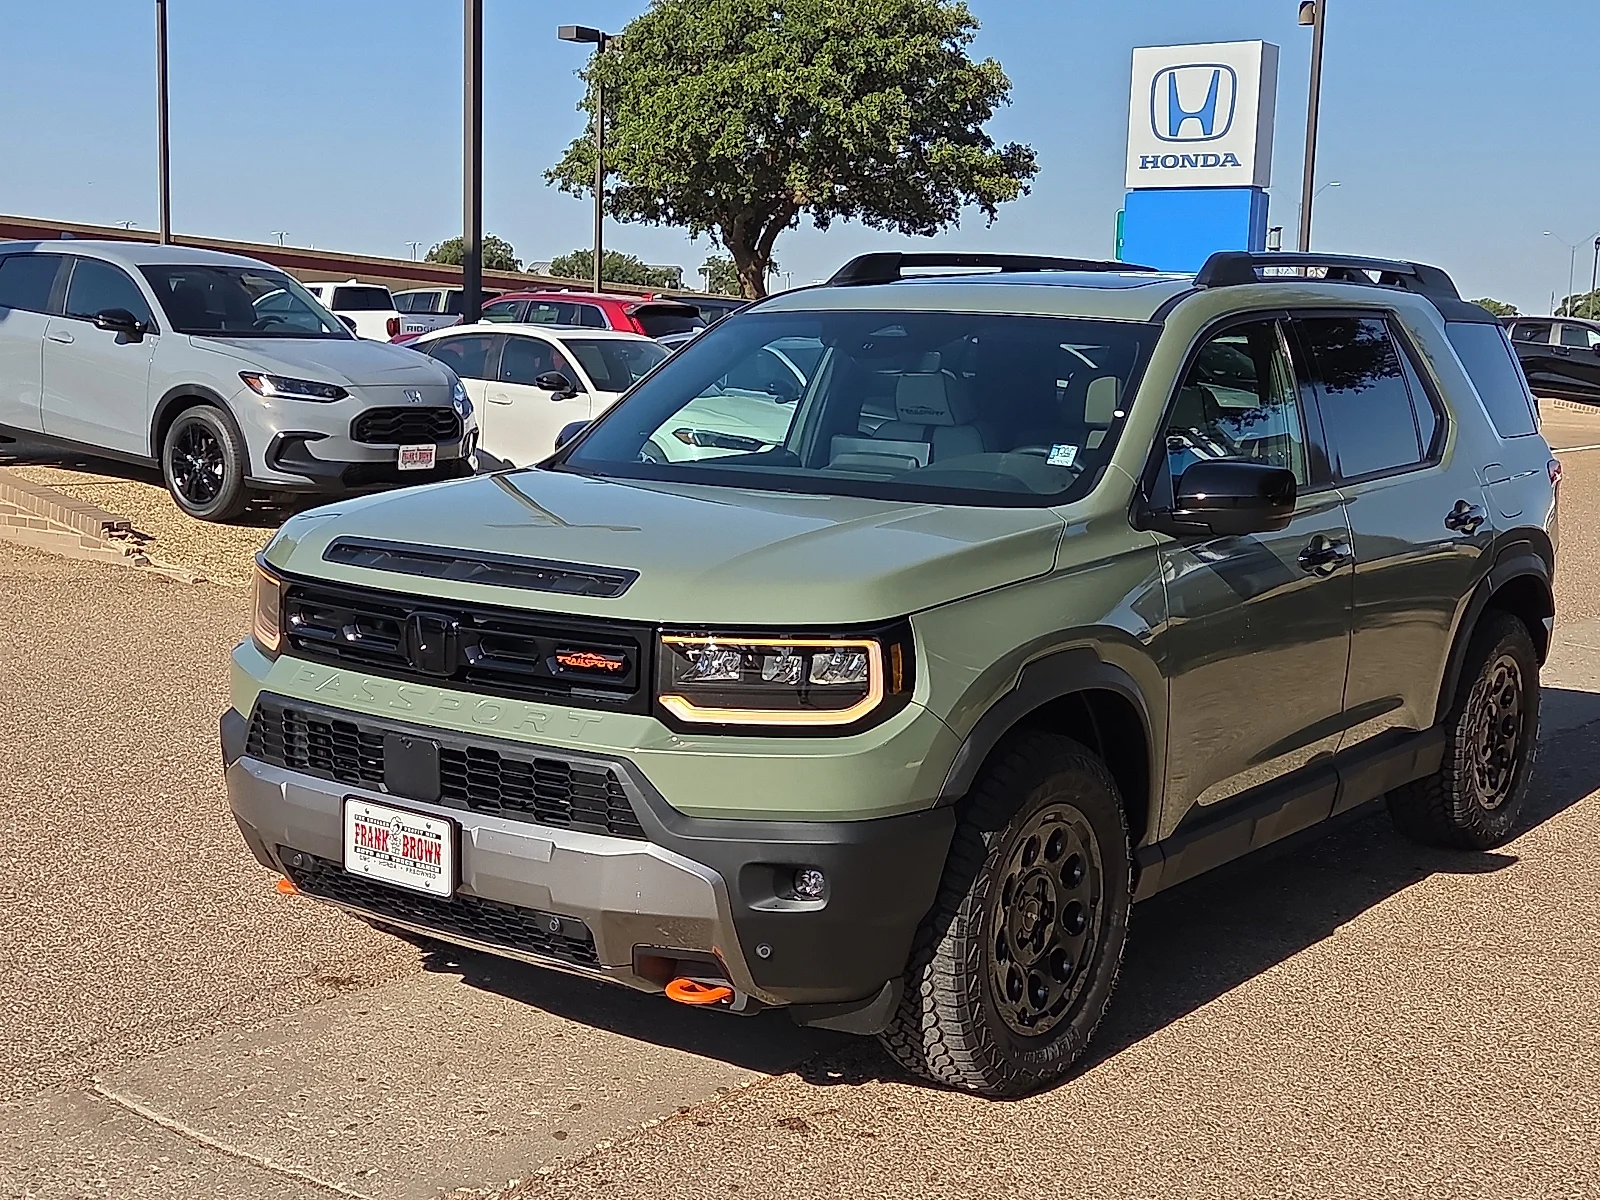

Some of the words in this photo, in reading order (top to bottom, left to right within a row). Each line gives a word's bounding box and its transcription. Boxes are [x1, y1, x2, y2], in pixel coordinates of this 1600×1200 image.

[1138, 152, 1242, 170] HONDA
[556, 655, 622, 671] TRAILSPORT
[289, 663, 604, 738] PASSPORT
[354, 822, 390, 852] FRANK
[401, 833, 442, 865] BROWN
